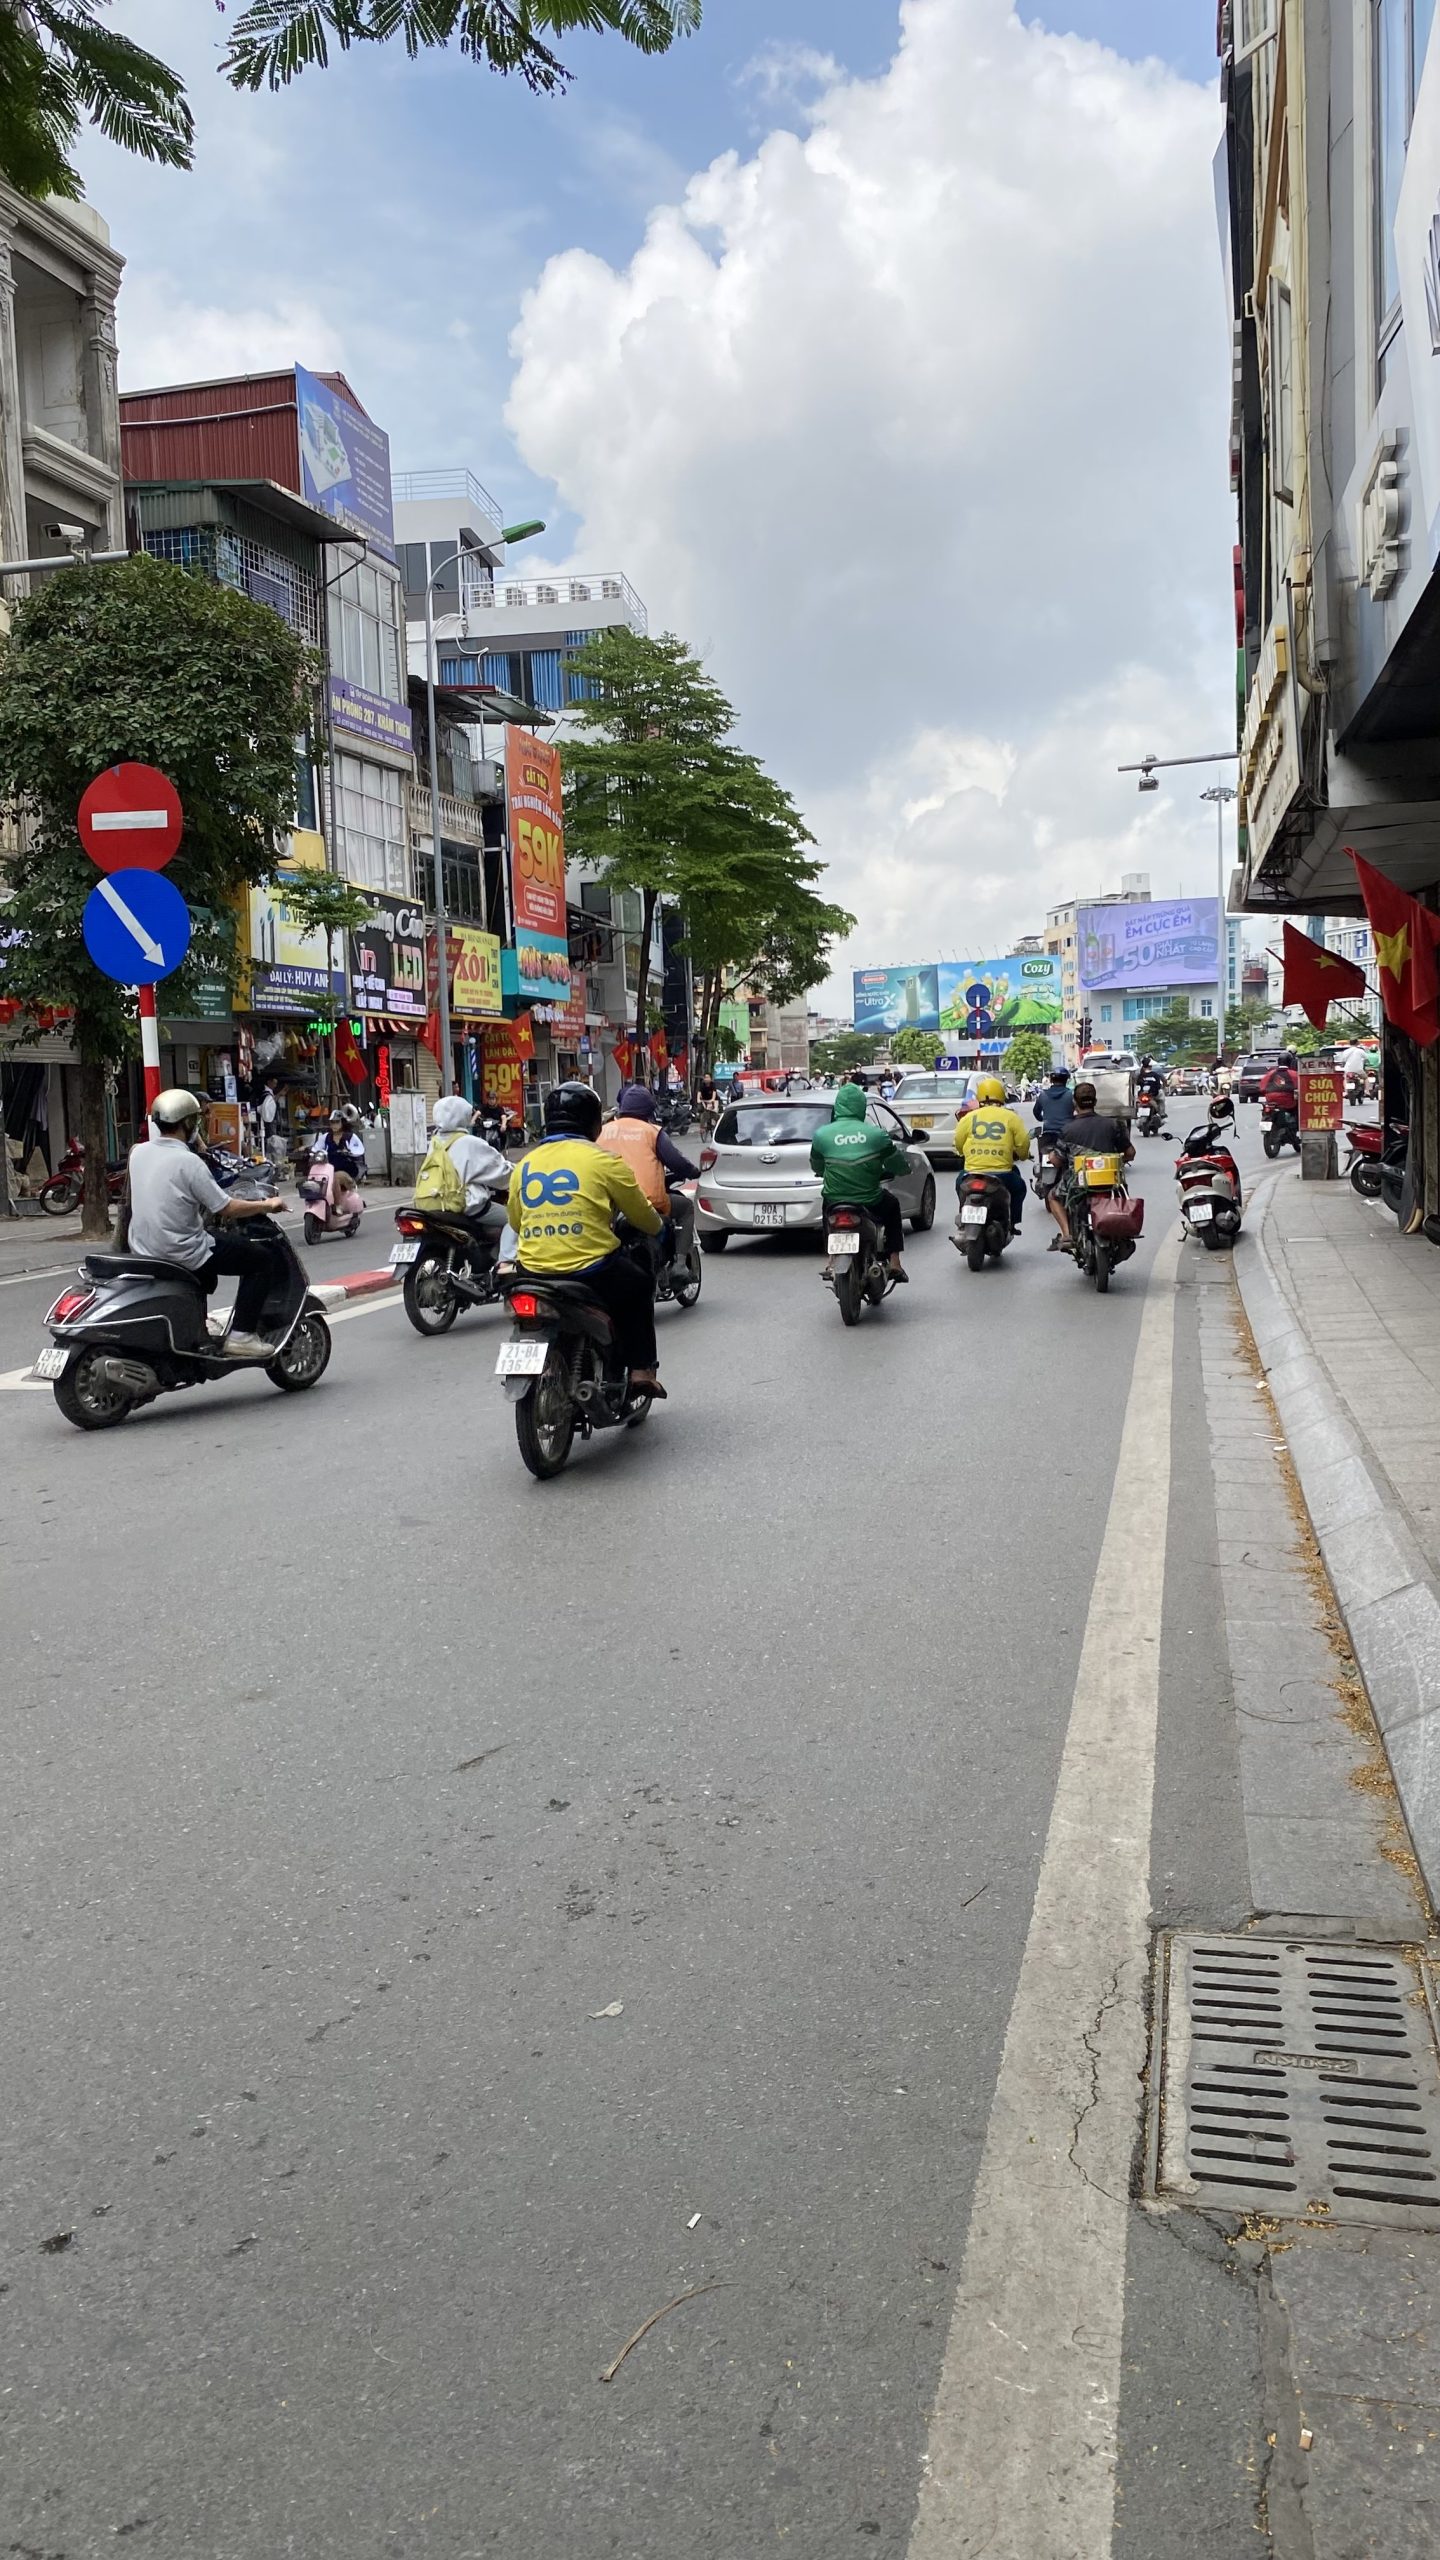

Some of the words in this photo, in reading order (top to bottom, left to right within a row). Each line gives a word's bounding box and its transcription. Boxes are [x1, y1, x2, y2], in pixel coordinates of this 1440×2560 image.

[518, 818, 561, 888] 59K
[1126, 927, 1143, 939] ÊM
[1173, 914, 1192, 927] ÊM
[392, 942, 424, 991] LED
[456, 946, 487, 983] XÔI
[1023, 963, 1051, 975] Cozy
[1123, 941, 1156, 972] 50
[270, 970, 283, 986] ĐẠI
[295, 970, 312, 986] HUY
[484, 1063, 520, 1094] 59K
[1309, 1077, 1334, 1090] SỬA
[1304, 1090, 1338, 1103] CHỮA
[1307, 1116, 1335, 1129] MÁY
[1313, 1105, 1329, 1116] XE
[834, 1132, 867, 1146] Grab
[971, 1115, 1006, 1140] be
[521, 1162, 580, 1209] be
